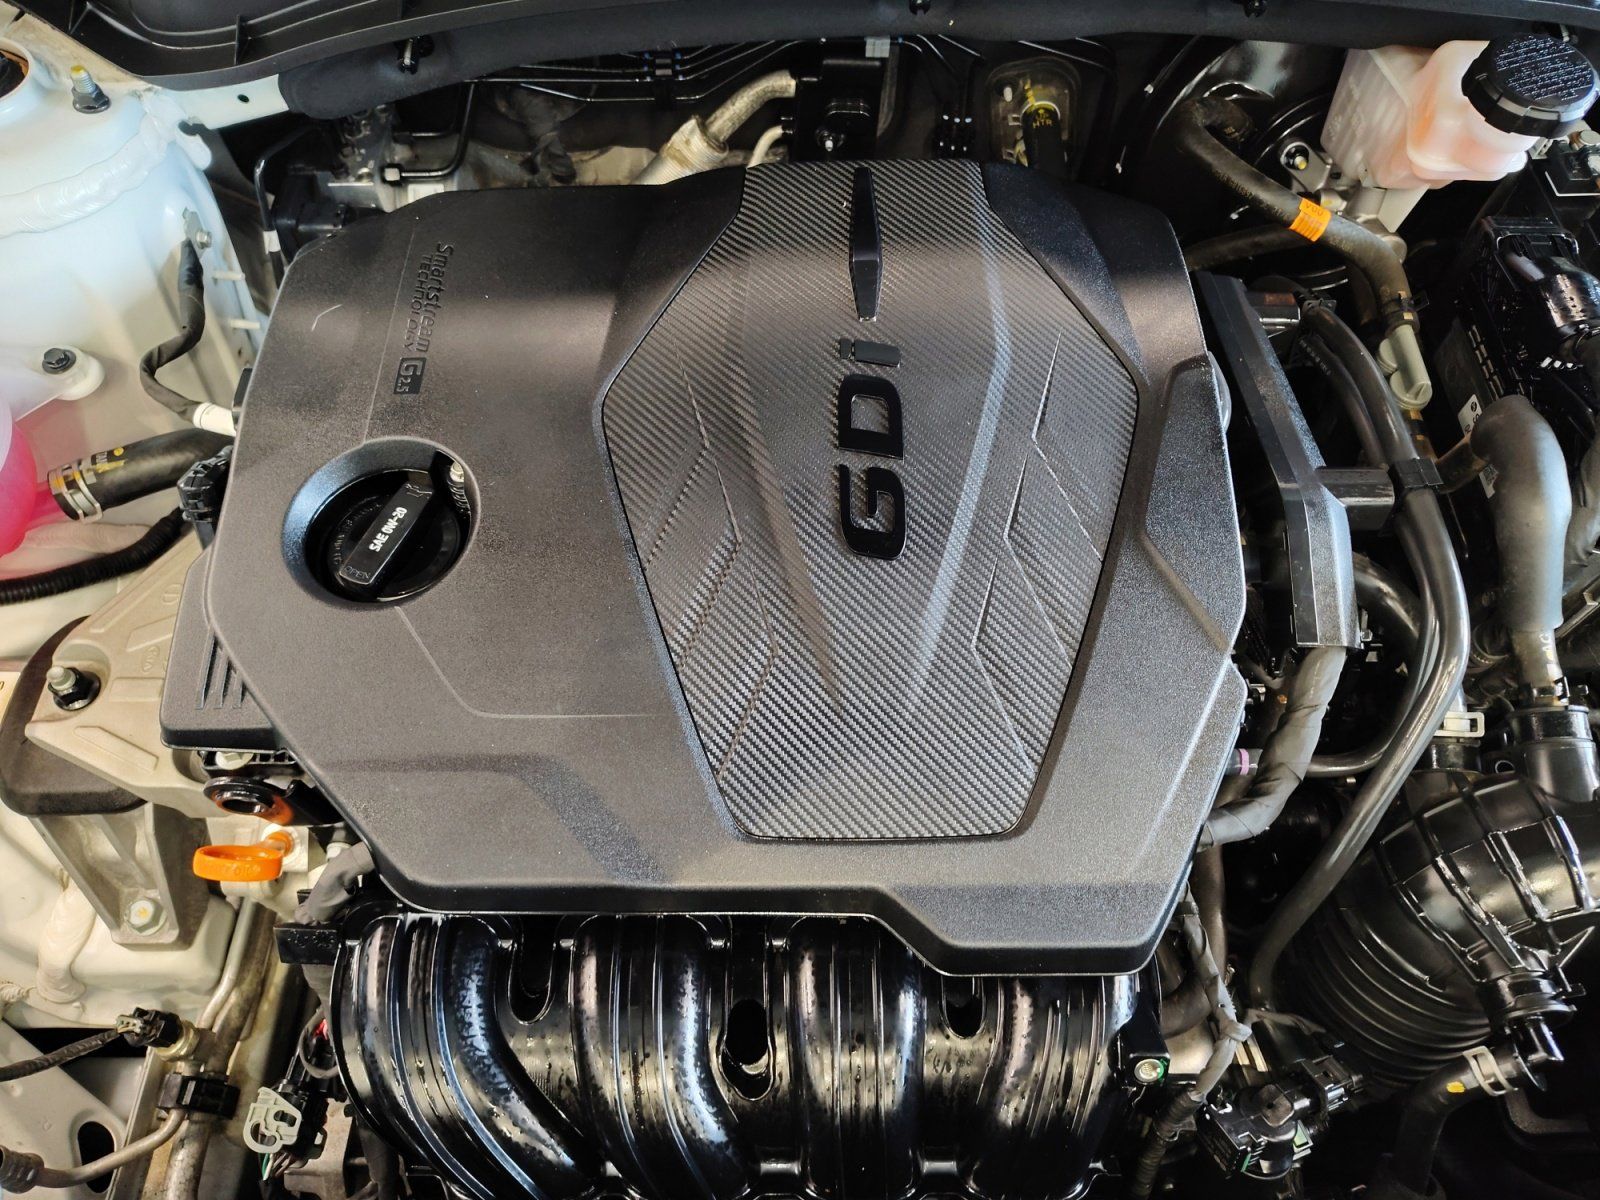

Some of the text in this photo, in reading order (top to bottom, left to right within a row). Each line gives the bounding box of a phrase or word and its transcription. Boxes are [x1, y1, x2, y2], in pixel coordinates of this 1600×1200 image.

[402, 254, 434, 353] TECHNOLOGY
[416, 243, 454, 353] Smartstream
[837, 338, 907, 562] GDi
[344, 565, 371, 581] OPEN
[368, 506, 408, 553] SAE 0W-20
